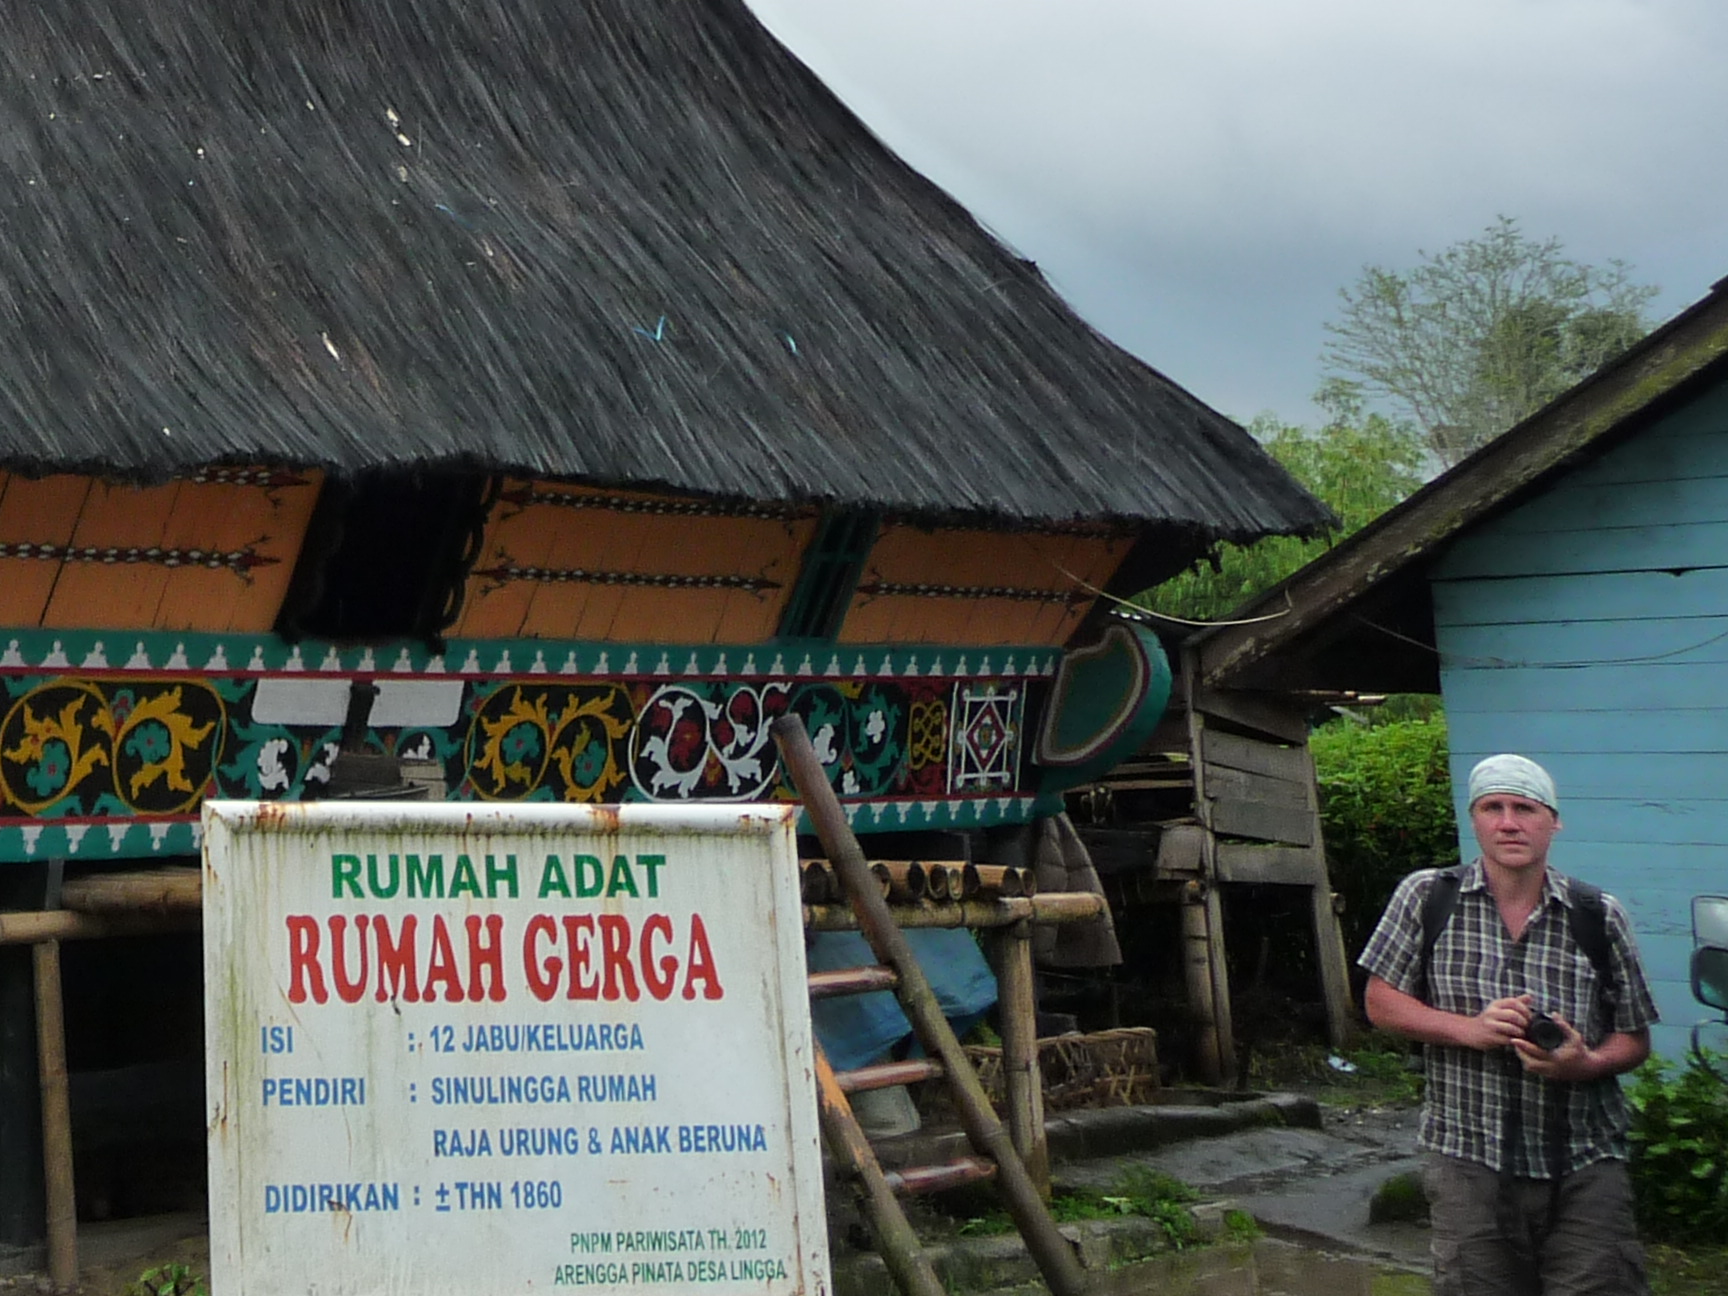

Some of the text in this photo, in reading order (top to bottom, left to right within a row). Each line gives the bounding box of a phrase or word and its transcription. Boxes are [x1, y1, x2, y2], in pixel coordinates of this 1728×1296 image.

[330, 853, 667, 900] RUMAH ADAT
[284, 912, 724, 1005] RUMAH GERGA
[261, 1026, 294, 1054] ISI
[429, 1025, 456, 1053] 12
[462, 1023, 645, 1053] JABU/KELUARGA
[261, 1077, 366, 1107] PENDIRI
[430, 1075, 572, 1105] SINULINGGA
[577, 1074, 658, 1103] RUMAH
[433, 1124, 769, 1158] RAJA URUNG & ANAK BERUNA
[264, 1182, 400, 1214] DIDIRIKAN
[509, 1180, 563, 1209] 1860
[570, 1232, 613, 1254] PNPM
[616, 1229, 704, 1253] PARIWISATA
[734, 1228, 768, 1251] 2012
[554, 1262, 629, 1286] ARENGGA
[632, 1261, 684, 1284] PINATA
[687, 1260, 727, 1282] DESA
